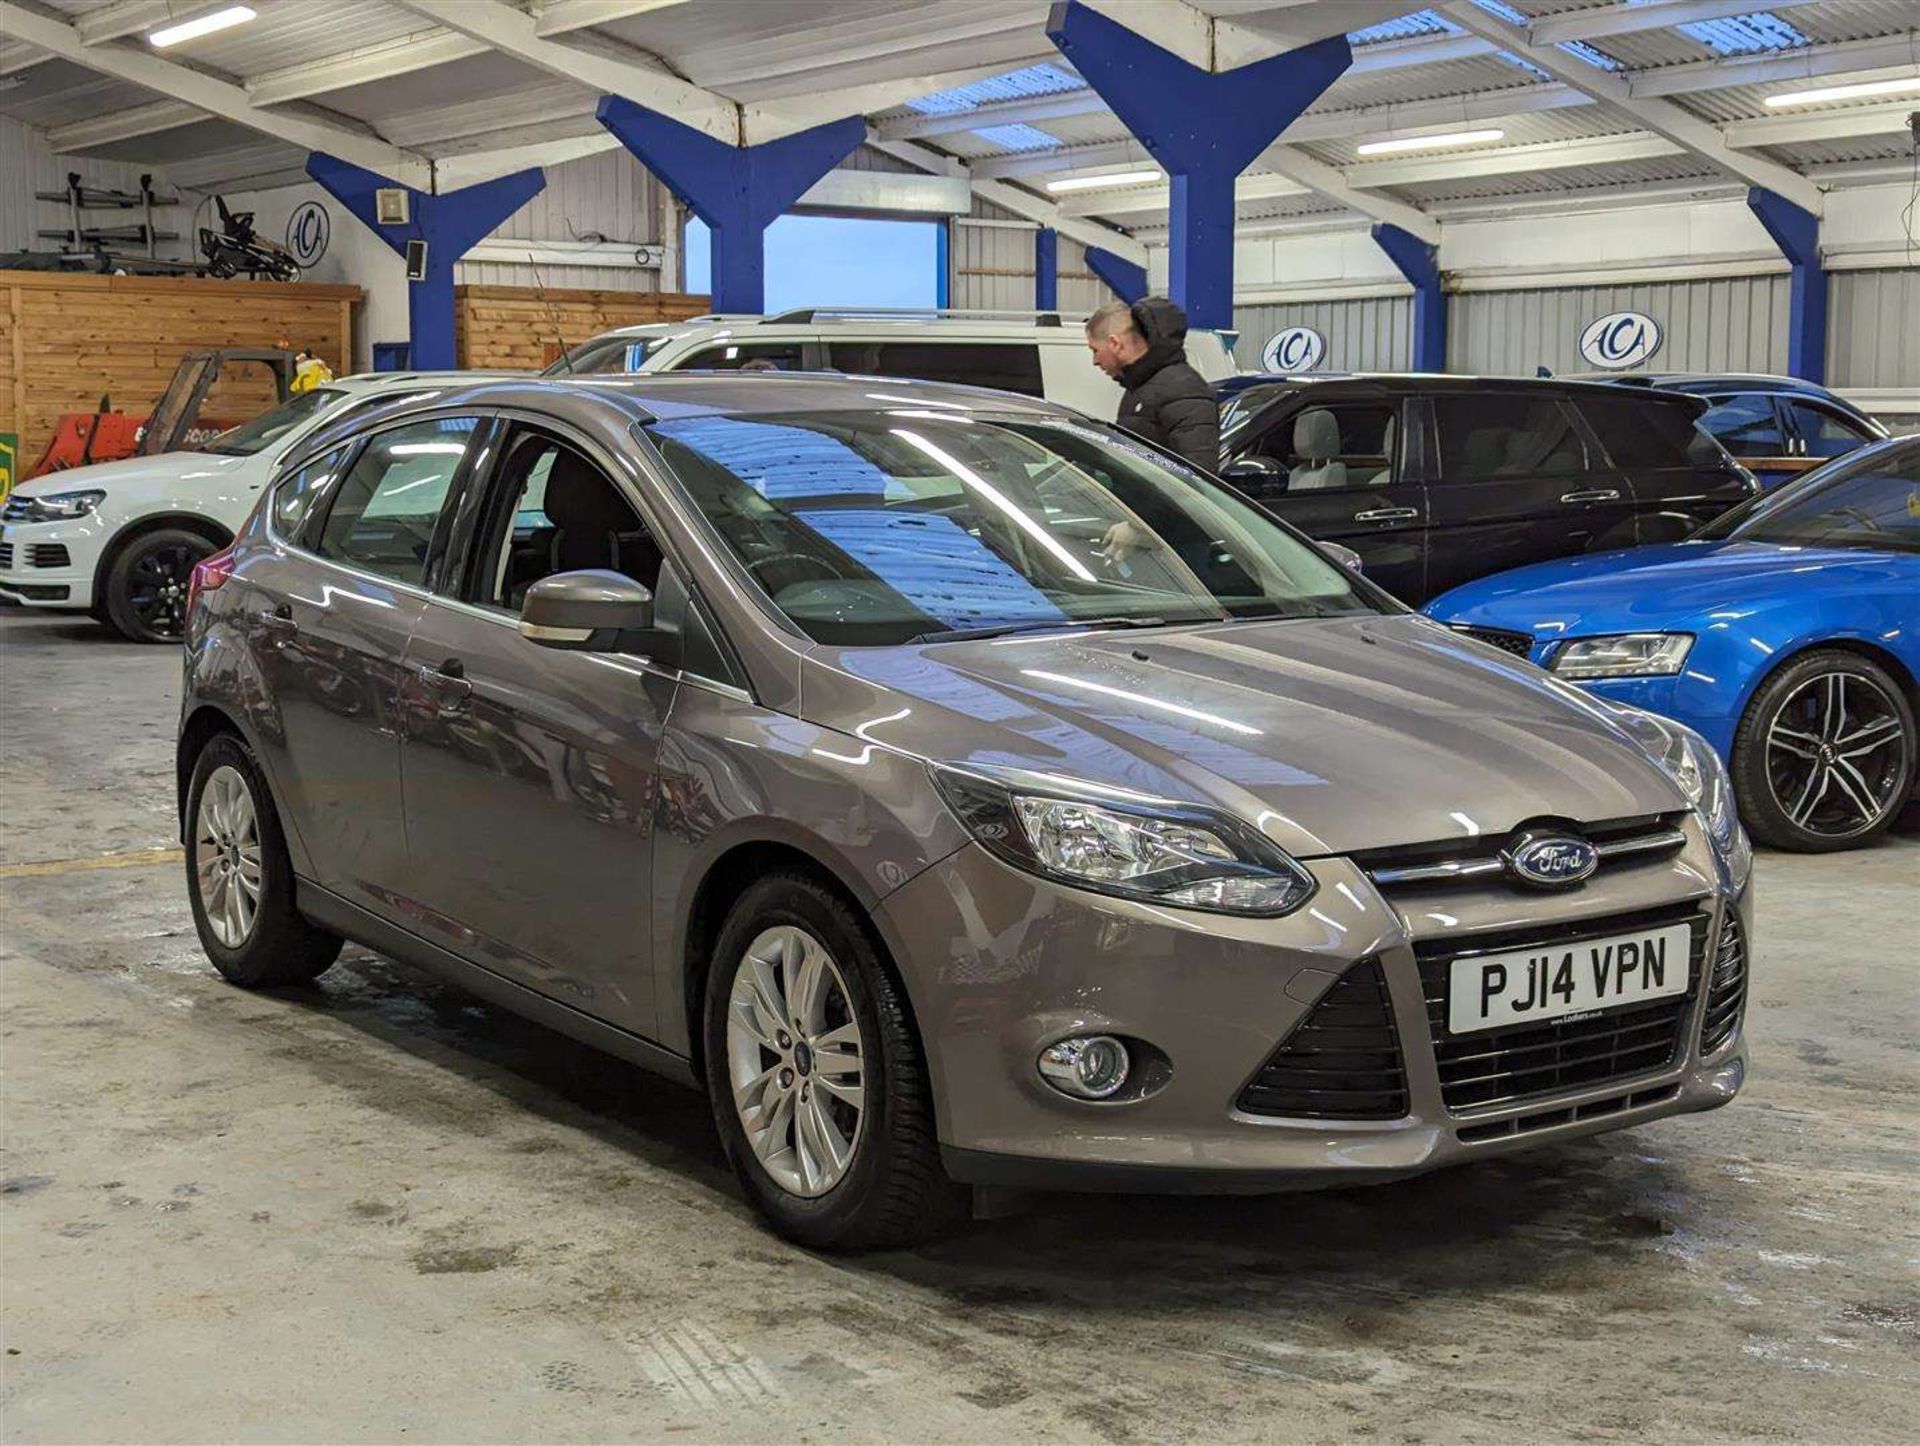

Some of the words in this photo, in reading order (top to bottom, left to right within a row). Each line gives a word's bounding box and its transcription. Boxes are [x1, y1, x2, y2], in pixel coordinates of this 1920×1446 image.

[291, 209, 323, 258] ACA
[1267, 332, 1313, 370] ACA
[1583, 317, 1645, 360] ACA
[1531, 846, 1582, 872] Ford
[1481, 952, 1576, 1017] PJ14
[1591, 937, 1666, 998] VPN
